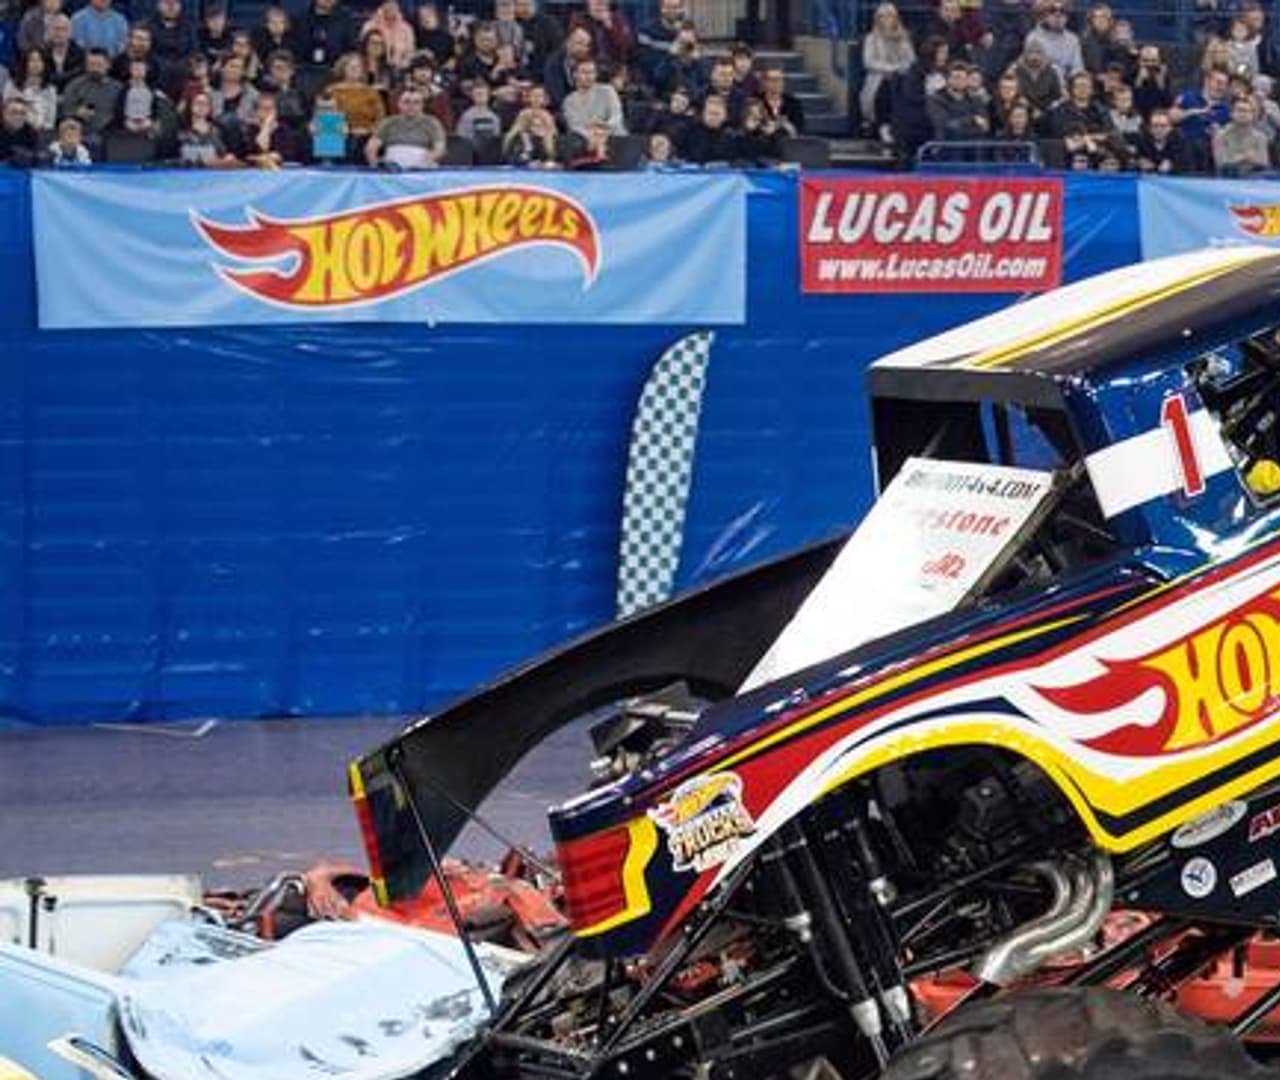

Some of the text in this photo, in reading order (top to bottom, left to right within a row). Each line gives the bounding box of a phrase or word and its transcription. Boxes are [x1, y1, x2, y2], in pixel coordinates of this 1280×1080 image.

[807, 191, 1054, 244] LUCAS OIL
[818, 252, 1047, 281] www.LucasOil.com
[1162, 395, 1204, 495] 1
